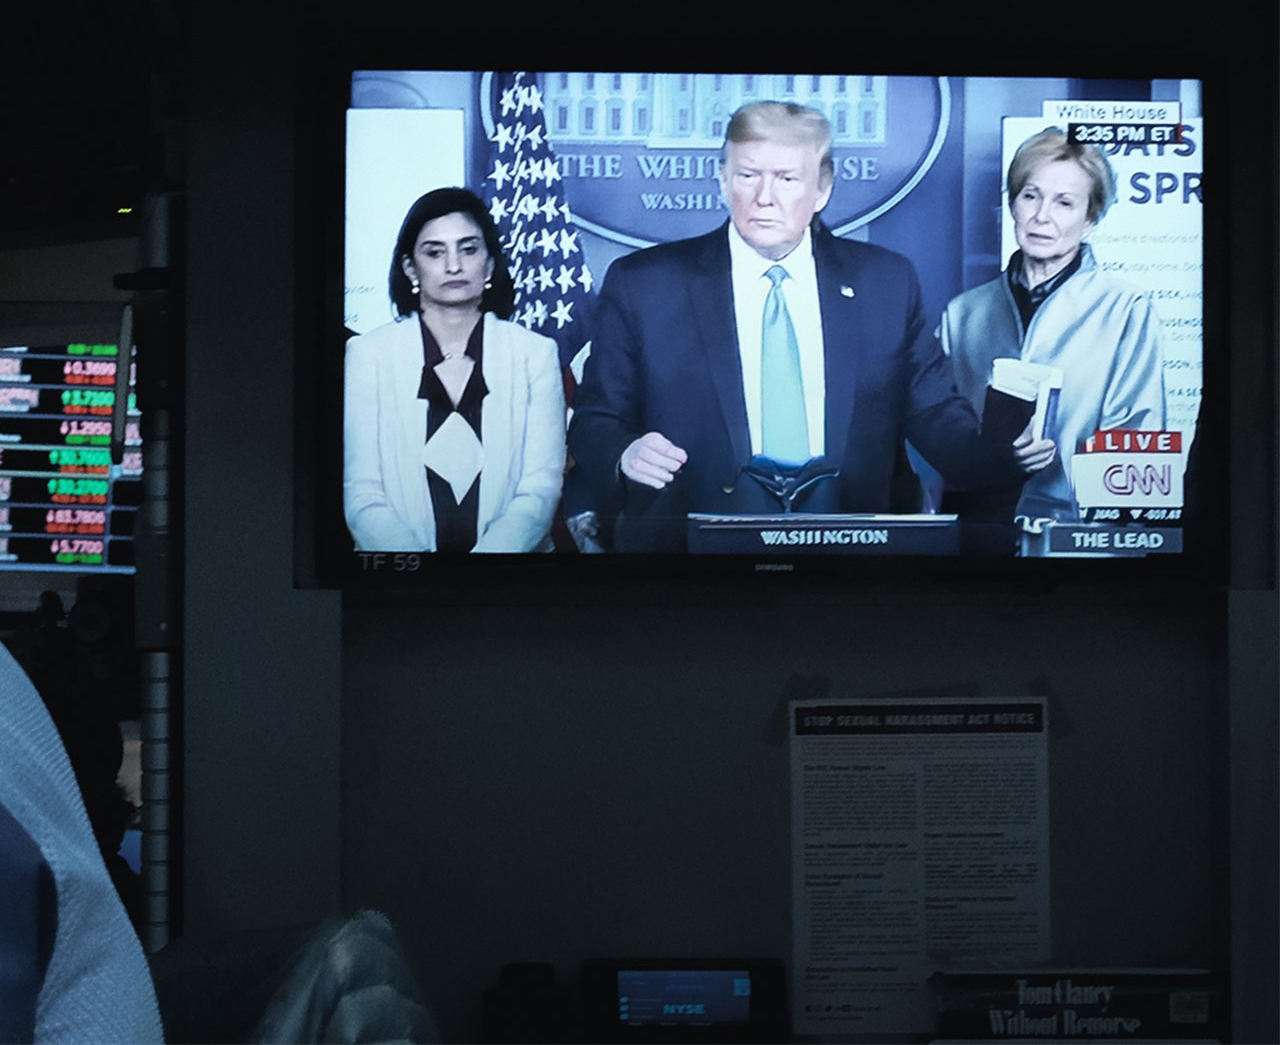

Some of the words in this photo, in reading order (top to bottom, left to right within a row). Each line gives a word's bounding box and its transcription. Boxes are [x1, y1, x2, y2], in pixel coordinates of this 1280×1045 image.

[1056, 104, 1107, 120] White
[1112, 105, 1168, 120] House
[1074, 125, 1114, 142] 3:35
[1117, 126, 1145, 142] PM
[1150, 126, 1174, 142] ET
[557, 155, 623, 179] THE
[637, 155, 722, 179] WHIT
[1105, 433, 1172, 451] LIVE
[1103, 463, 1172, 496] CNN
[761, 529, 888, 546] WASHINGTON
[1071, 532, 1109, 549] THE
[1113, 532, 1164, 549] LEAD
[803, 715, 833, 727] STOP
[837, 715, 882, 726] SEXUAL
[885, 714, 965, 726] HARASSMENT
[967, 713, 991, 725] ACT
[993, 713, 1036, 725] NOTICE
[1016, 979, 1052, 1005] Tom
[1054, 979, 1115, 1008] Clancy
[988, 1010, 1058, 1036] Without
[1062, 1010, 1142, 1035] Remorse
